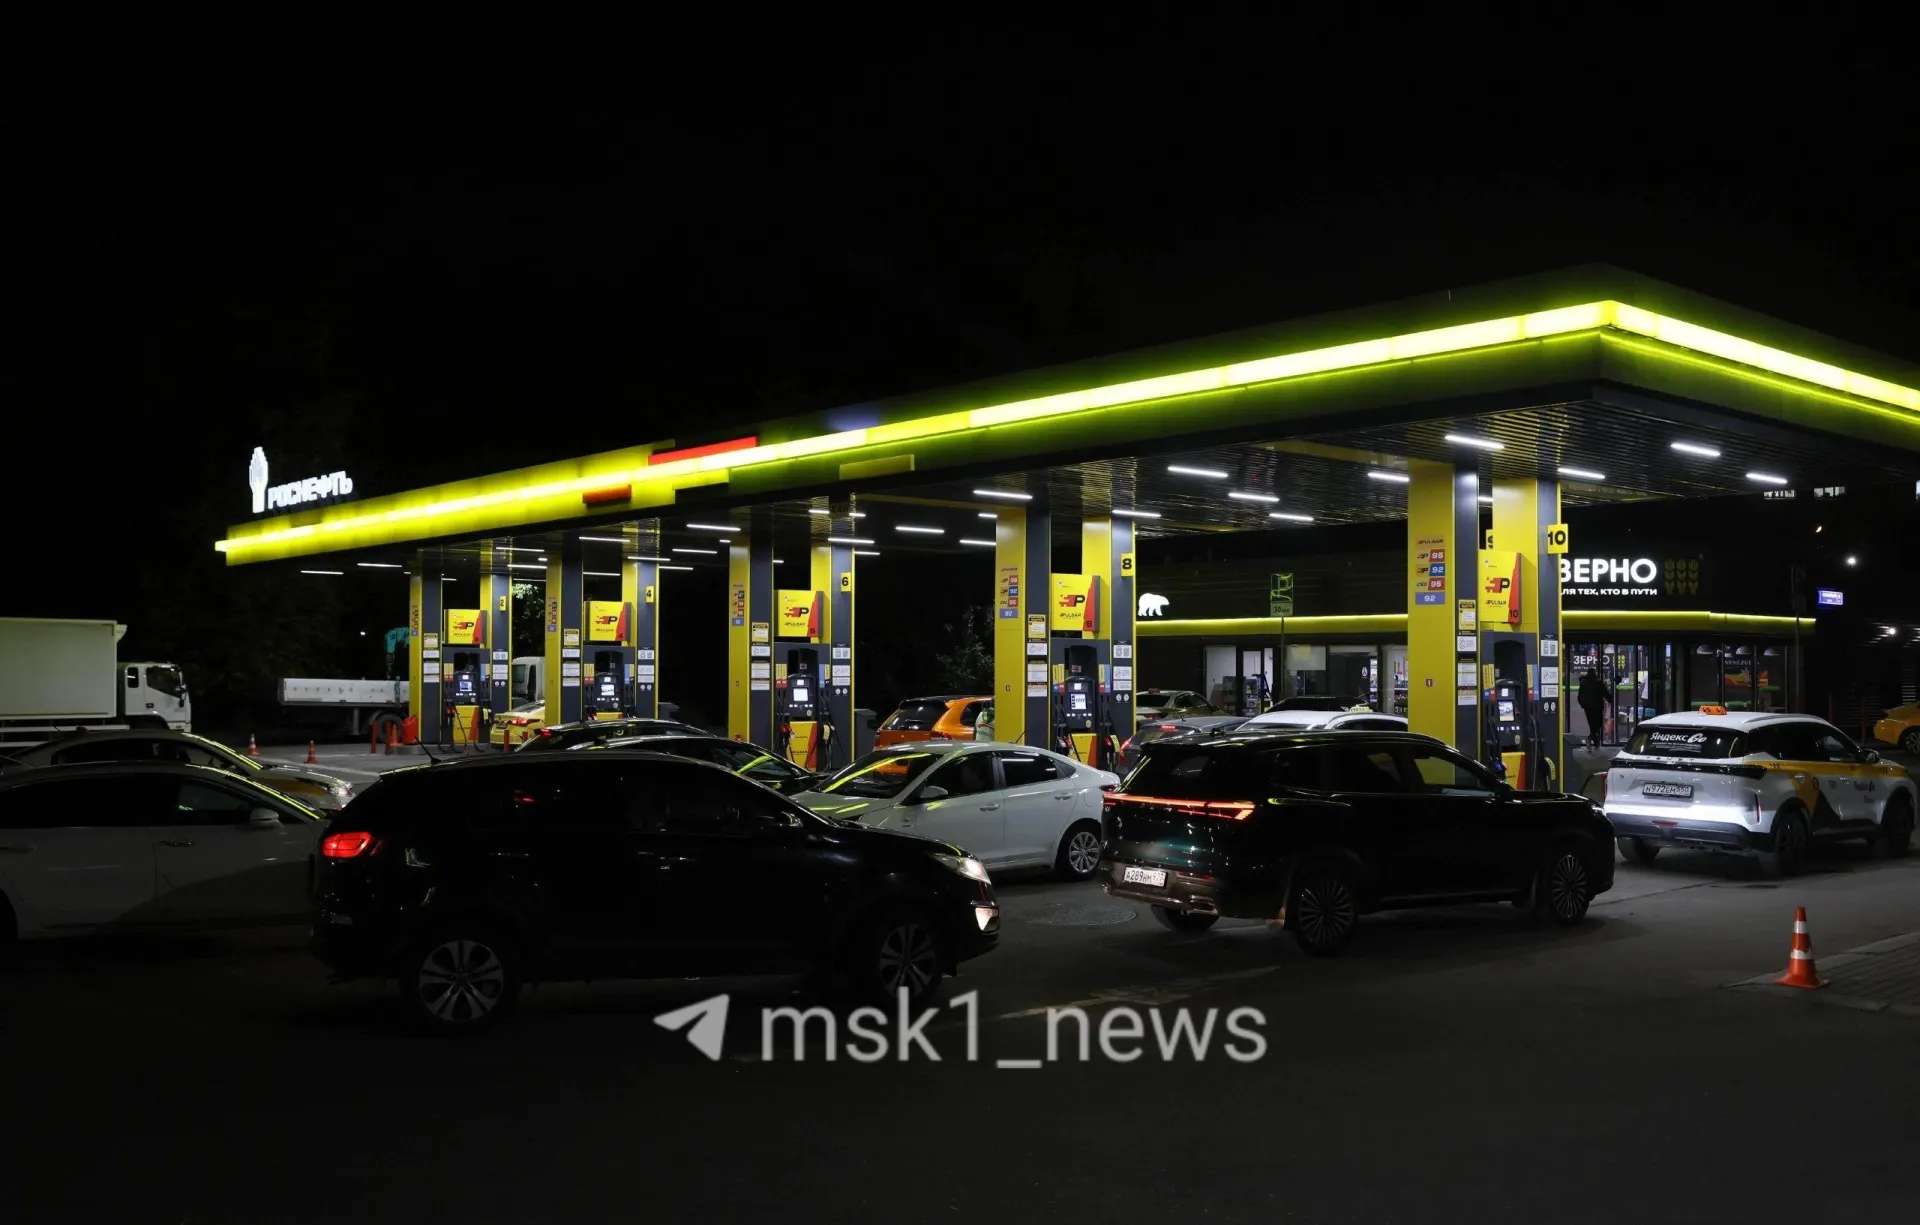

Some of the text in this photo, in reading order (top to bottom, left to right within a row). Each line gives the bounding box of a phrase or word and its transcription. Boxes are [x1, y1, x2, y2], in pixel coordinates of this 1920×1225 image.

[267, 470, 353, 510] РОСНЕФТЬ
[1548, 530, 1566, 546] 10
[1122, 558, 1132, 570] 8
[1431, 566, 1444, 574] 92
[1561, 558, 1657, 584] ЗЕРНО
[842, 576, 849, 587] 6
[1430, 580, 1442, 588] 95
[1561, 588, 1658, 596] ЛЯ ТЕХ, КТО В ПУТИ
[1650, 731, 1708, 744] Яндекс Go
